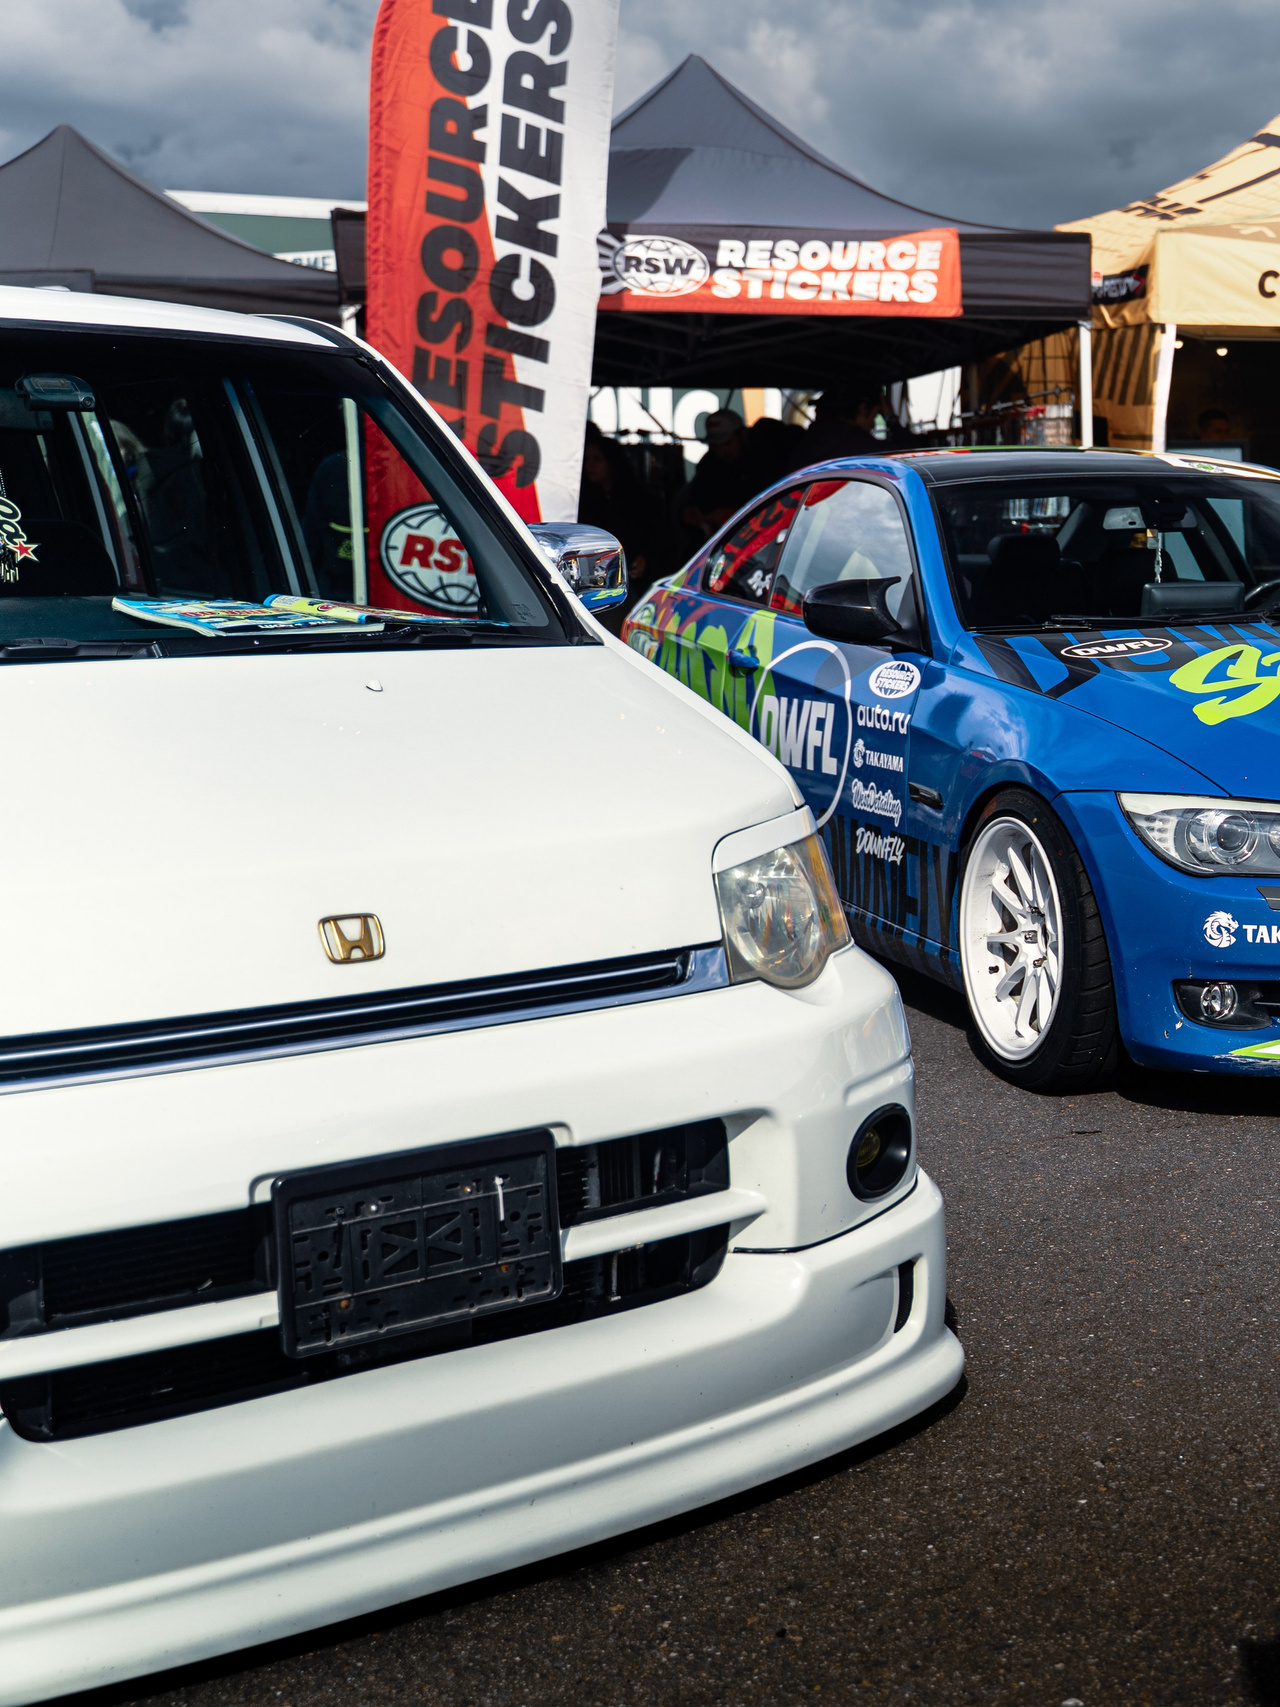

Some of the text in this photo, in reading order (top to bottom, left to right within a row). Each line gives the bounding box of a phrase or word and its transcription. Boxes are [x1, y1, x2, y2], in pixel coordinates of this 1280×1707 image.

[477, 0, 573, 488] STICKERS
[715, 239, 943, 271] RESOURCE
[623, 255, 697, 276] RSW
[711, 269, 939, 303] STICKERS
[399, 533, 477, 576] RS
[1071, 638, 1164, 657] DWFL
[876, 677, 912, 691] STICKERS
[879, 668, 915, 682] RESOURCE
[760, 694, 838, 776] DWFL
[856, 704, 912, 735] auto.ru
[865, 749, 904, 773] TAKAYAMA
[856, 827, 906, 867] DOWNFLY
